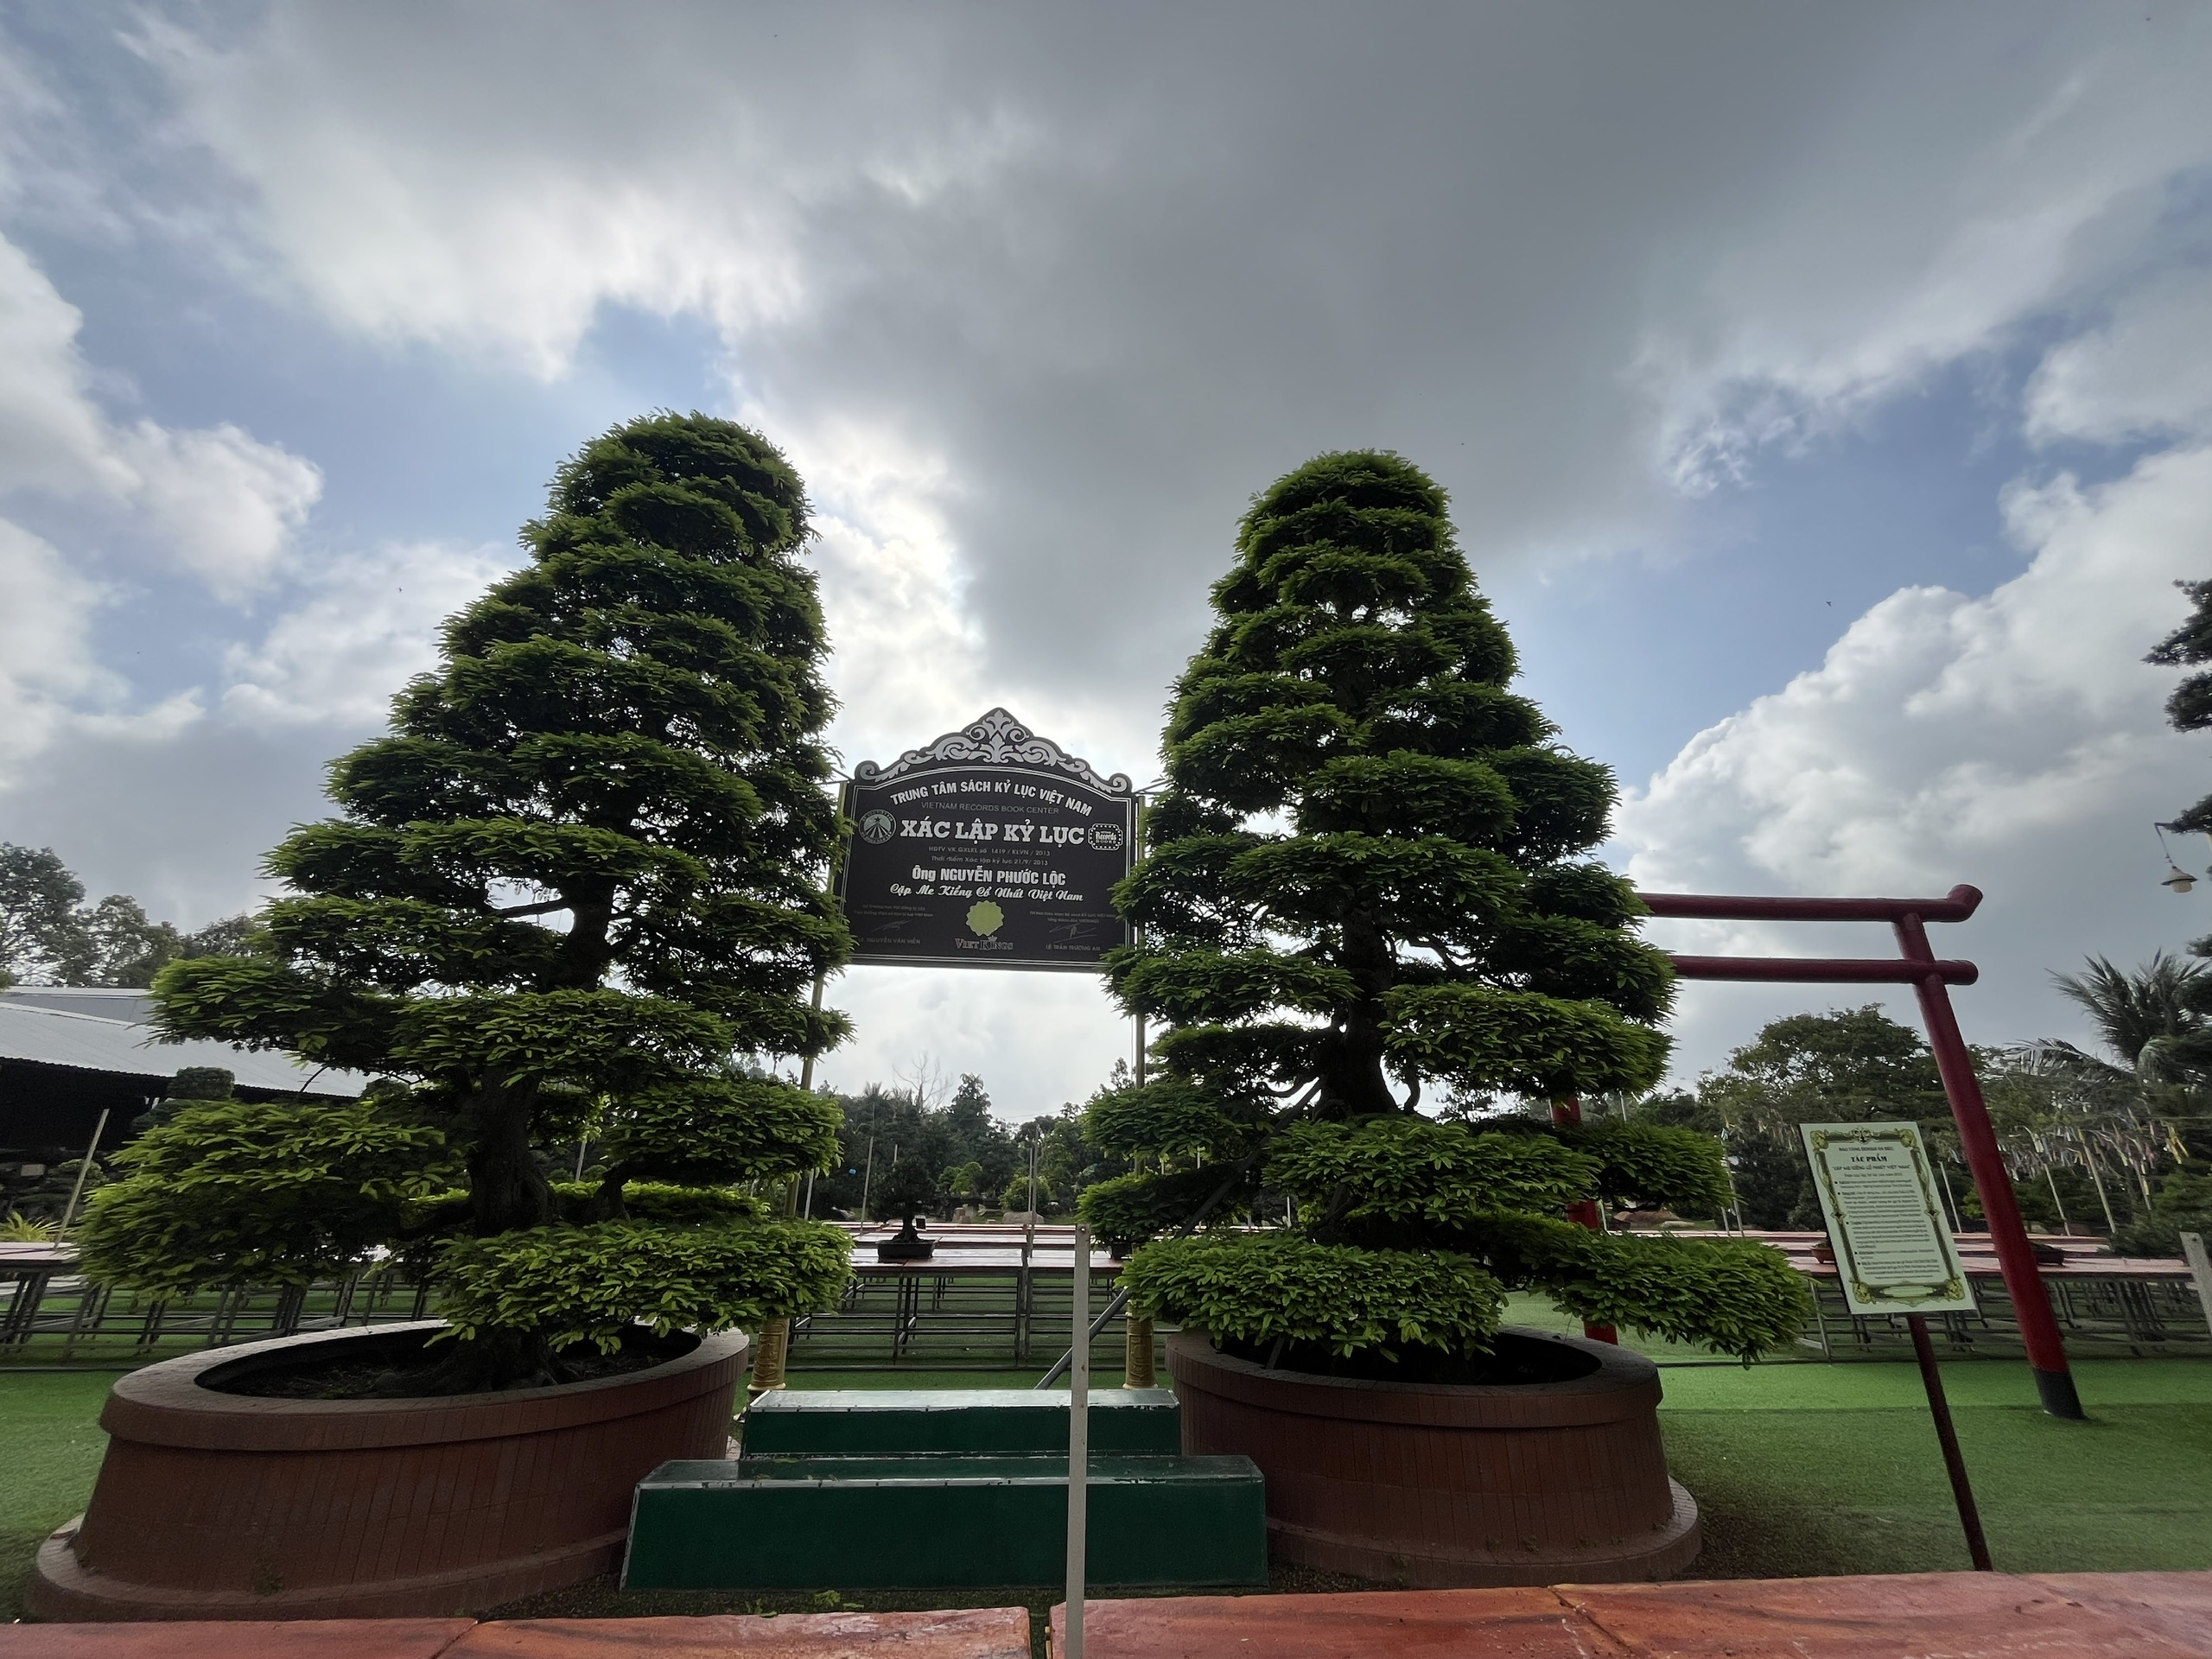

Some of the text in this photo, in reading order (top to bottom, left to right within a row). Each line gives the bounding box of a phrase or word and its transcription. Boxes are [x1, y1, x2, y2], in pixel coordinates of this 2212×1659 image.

[890, 779, 1093, 817] TRUNG TÂM SÁCH KỶ LỤC VIỆT NAM
[921, 801, 957, 810] VIETNAM
[959, 803, 1000, 812] RECORDS
[1026, 806, 1059, 815] CENTER
[900, 816, 950, 838] XÁC
[955, 817, 999, 844] LẬP
[1003, 819, 1035, 842] KỶ
[1039, 825, 1084, 848] LỤC
[912, 864, 1066, 888] Ông NGUYỄN PHƯỚC LỘC
[890, 883, 1084, 902] Cặp Me Kiểng Cổ Nhất Việt Nam
